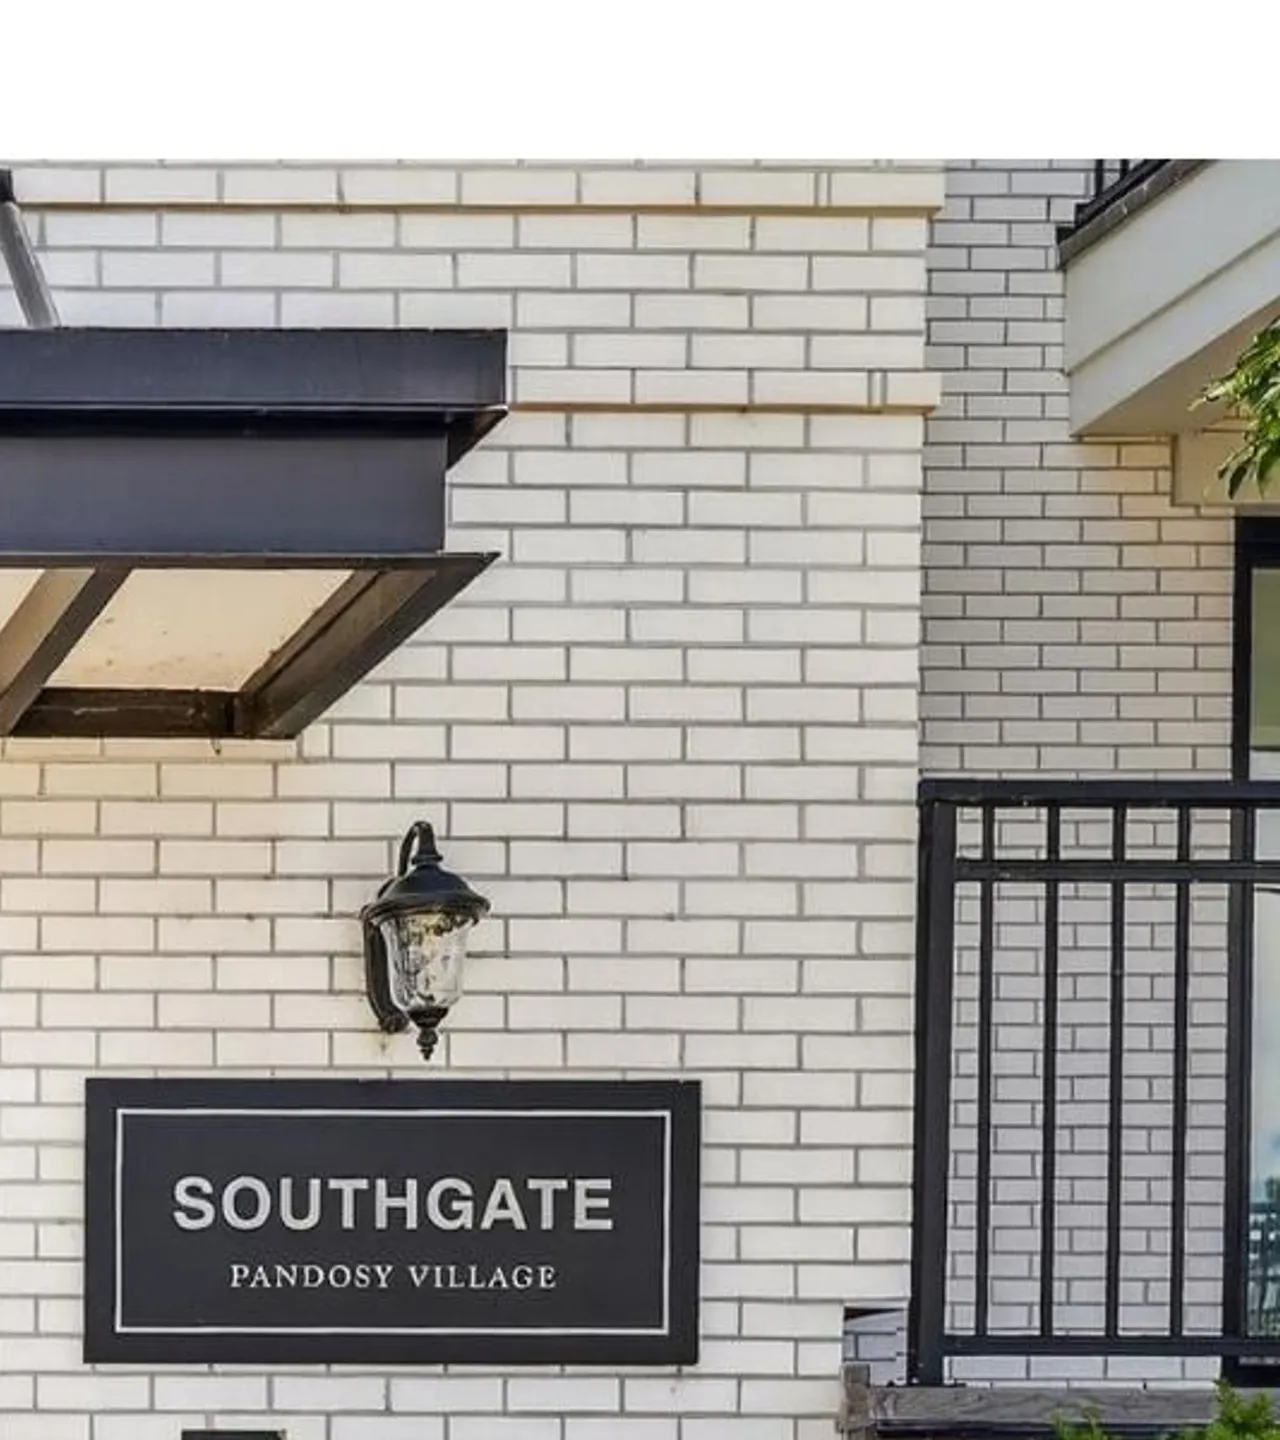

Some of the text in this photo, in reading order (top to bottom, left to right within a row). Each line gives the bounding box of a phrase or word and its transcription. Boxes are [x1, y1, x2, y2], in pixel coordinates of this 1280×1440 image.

[172, 1175, 615, 1231] SOUTHGATE
[229, 1263, 558, 1289] PANDOSY VILLAGE
